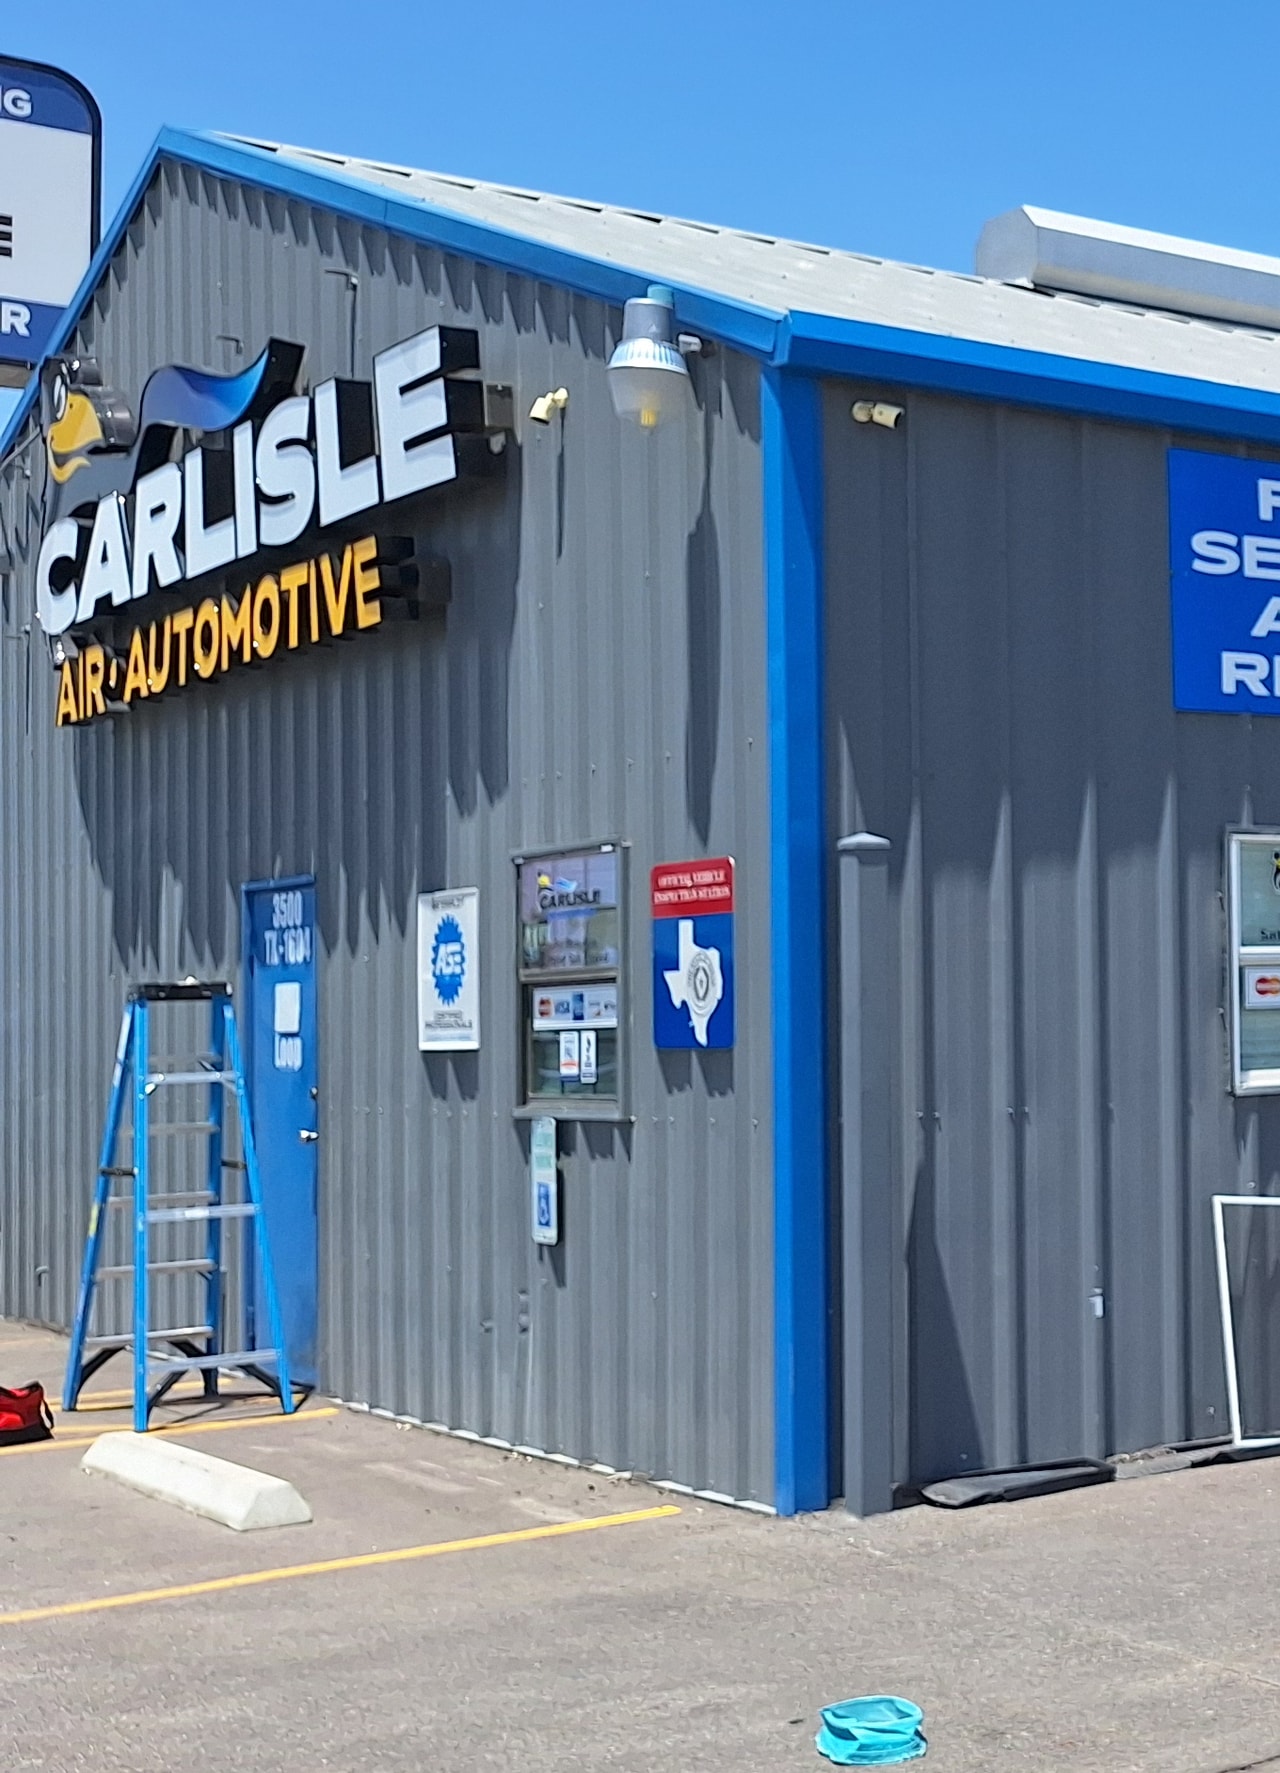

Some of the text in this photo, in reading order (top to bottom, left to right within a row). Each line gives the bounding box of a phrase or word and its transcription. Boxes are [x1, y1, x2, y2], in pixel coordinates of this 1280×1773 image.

[0, 85, 33, 118] G
[36, 325, 457, 635] CARLISLE
[56, 534, 382, 727] AIR AUTOMOTIVE
[272, 890, 303, 929] 3500
